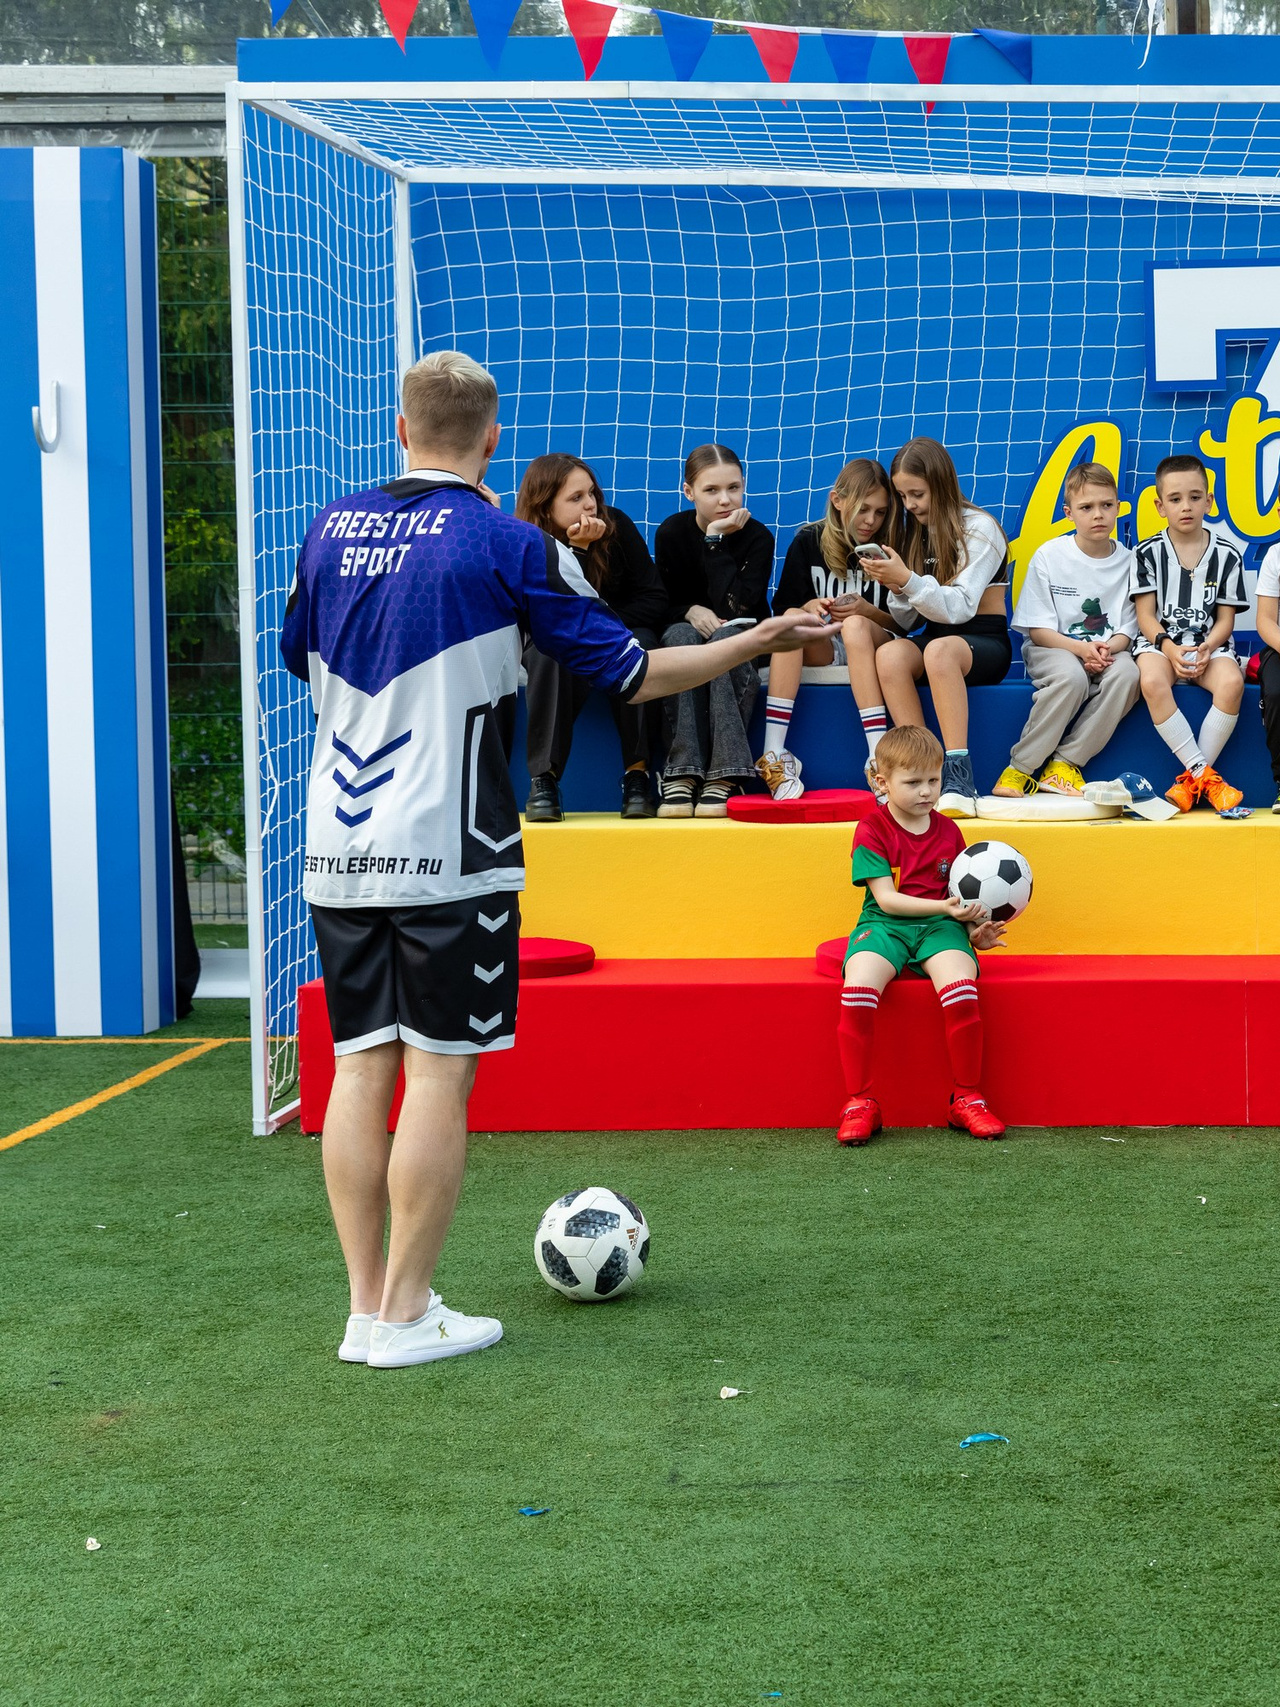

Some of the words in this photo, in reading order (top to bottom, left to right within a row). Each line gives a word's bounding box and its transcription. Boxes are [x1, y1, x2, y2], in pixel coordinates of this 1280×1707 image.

[321, 508, 453, 540] FREESTYLE
[340, 543, 412, 577] SPORT
[1162, 603, 1207, 623] Jeep
